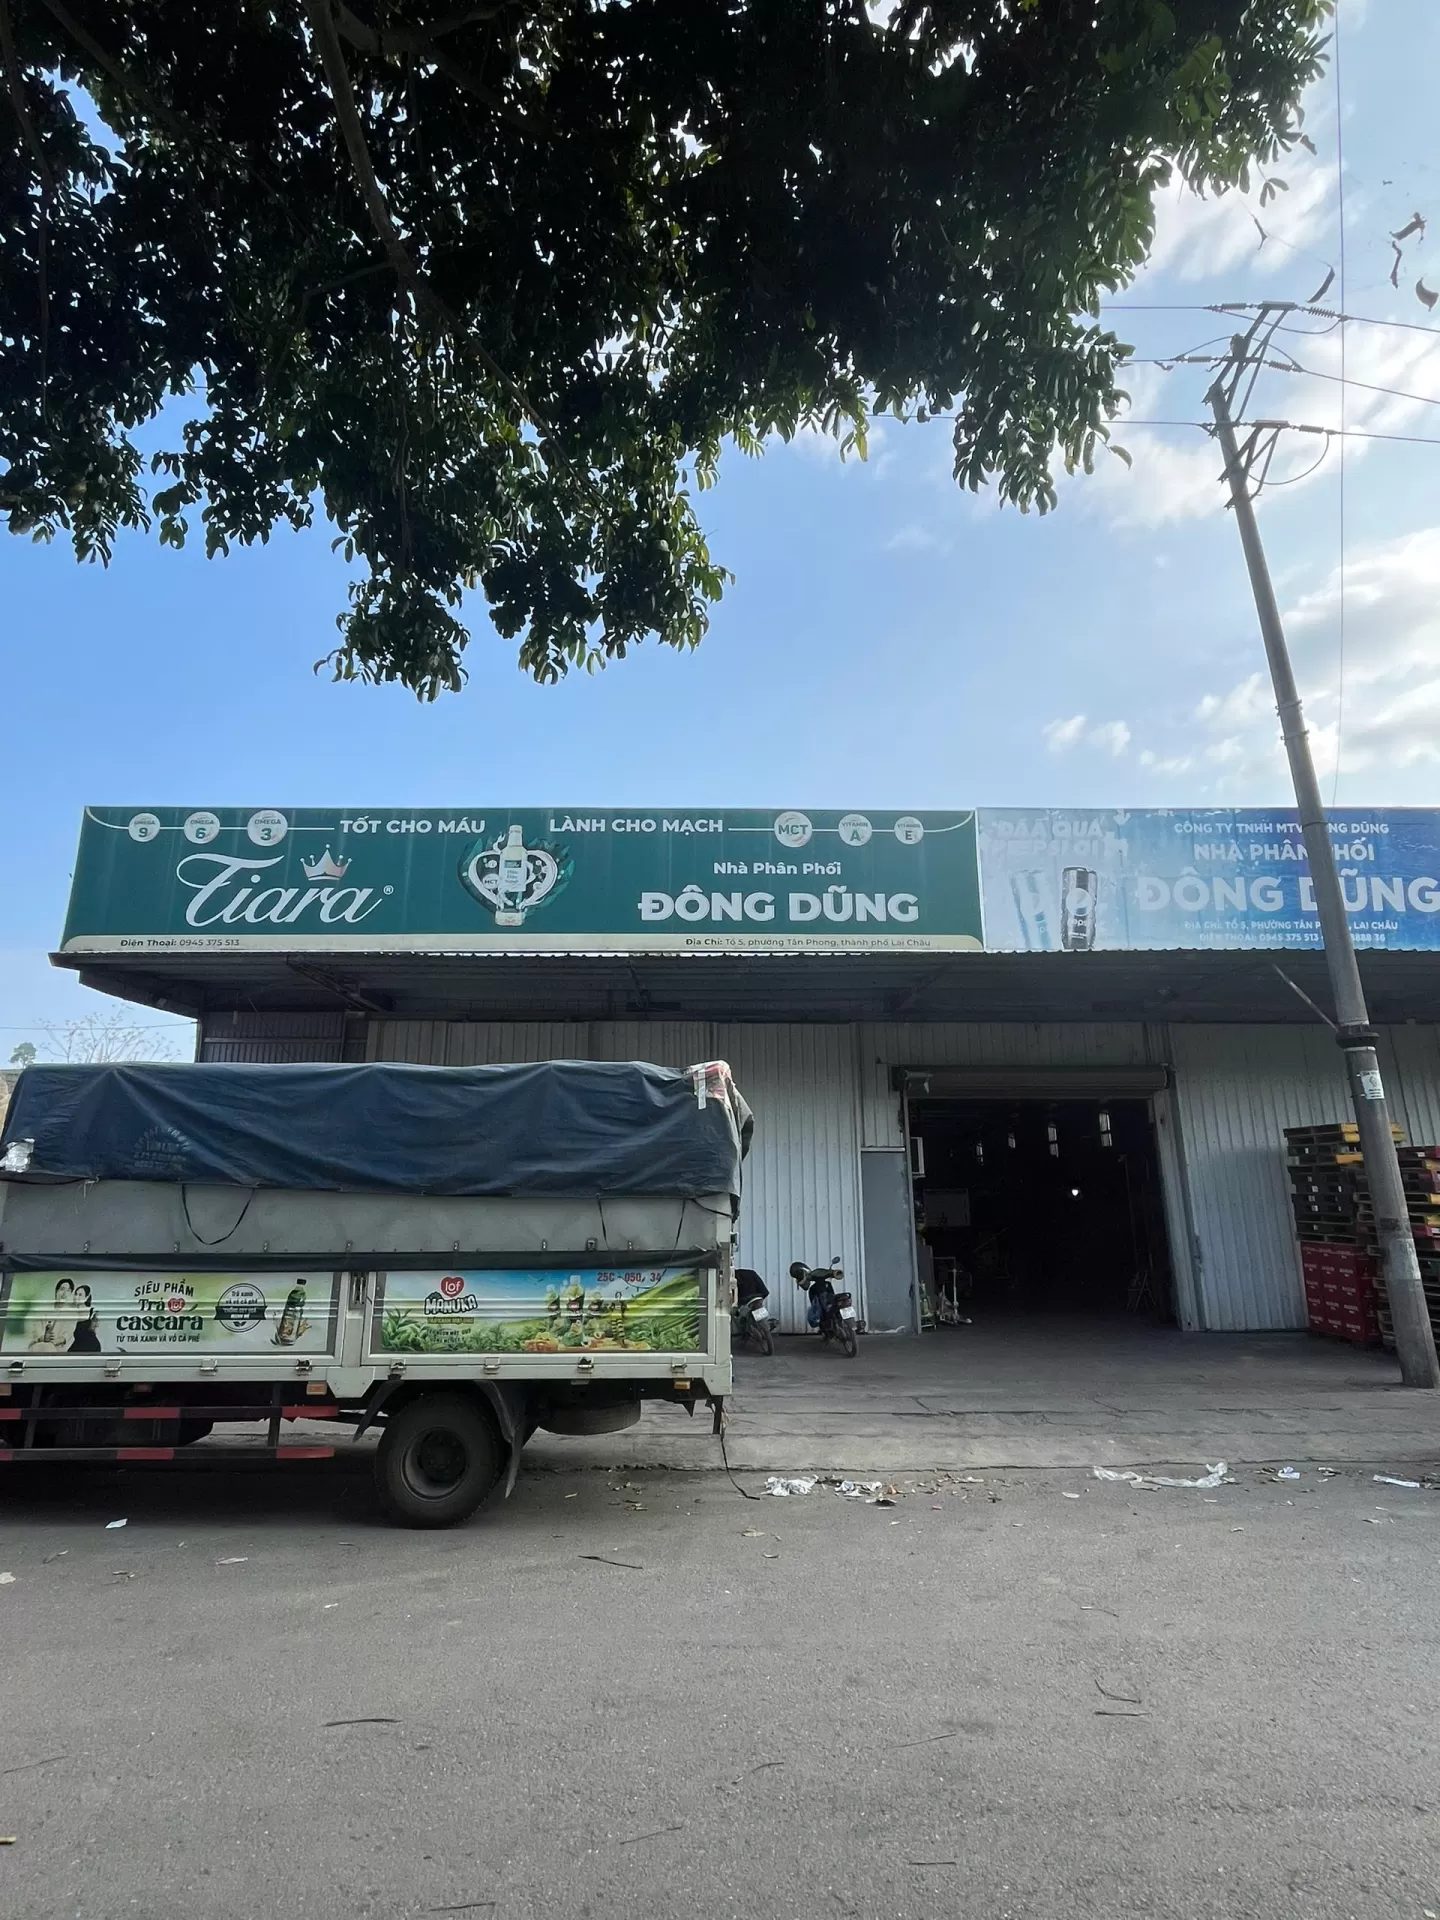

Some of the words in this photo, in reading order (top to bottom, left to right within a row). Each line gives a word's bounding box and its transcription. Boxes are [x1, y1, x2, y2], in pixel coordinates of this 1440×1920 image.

[340, 815, 382, 834] TỐT
[386, 819, 432, 834] CHO
[438, 816, 486, 834] MÁU
[550, 815, 606, 832] LÀNH
[611, 818, 657, 833] CHO
[662, 818, 723, 836] MẠCH
[778, 824, 809, 835] MCT
[1174, 820, 1213, 833] CÔNG
[1216, 823, 1232, 833] TY
[1236, 822, 1273, 833] TNHH
[1276, 822, 1302, 834] MTV
[1351, 821, 1389, 834] DŨNG
[138, 827, 148, 838] 9
[195, 827, 206, 839] 6
[260, 828, 272, 841] 3
[850, 830, 861, 842] A
[905, 830, 913, 841] E
[1193, 840, 1244, 861] NHÀ
[1331, 837, 1375, 861] HỐI
[713, 862, 748, 875] Nhà
[753, 862, 797, 875] Phân
[802, 861, 842, 875] Phối
[176, 853, 383, 927] Tiara
[1136, 867, 1283, 912] ĐÔNG
[637, 884, 775, 922] ĐÔNG
[788, 884, 919, 922] DŨNG
[1353, 921, 1369, 930] LAI
[179, 938, 204, 946] 0945
[206, 938, 223, 946] 375
[225, 938, 240, 946] 513
[806, 938, 839, 947] Phong,
[1285, 933, 1301, 941] 375
[1304, 933, 1319, 941] 513
[597, 1272, 615, 1282] 25C
[134, 1280, 160, 1297] SIÊU
[163, 1278, 194, 1297] PHẨM
[138, 1297, 165, 1311] Trà
[424, 1293, 478, 1315] MANUKA
[116, 1315, 203, 1331] cascara
